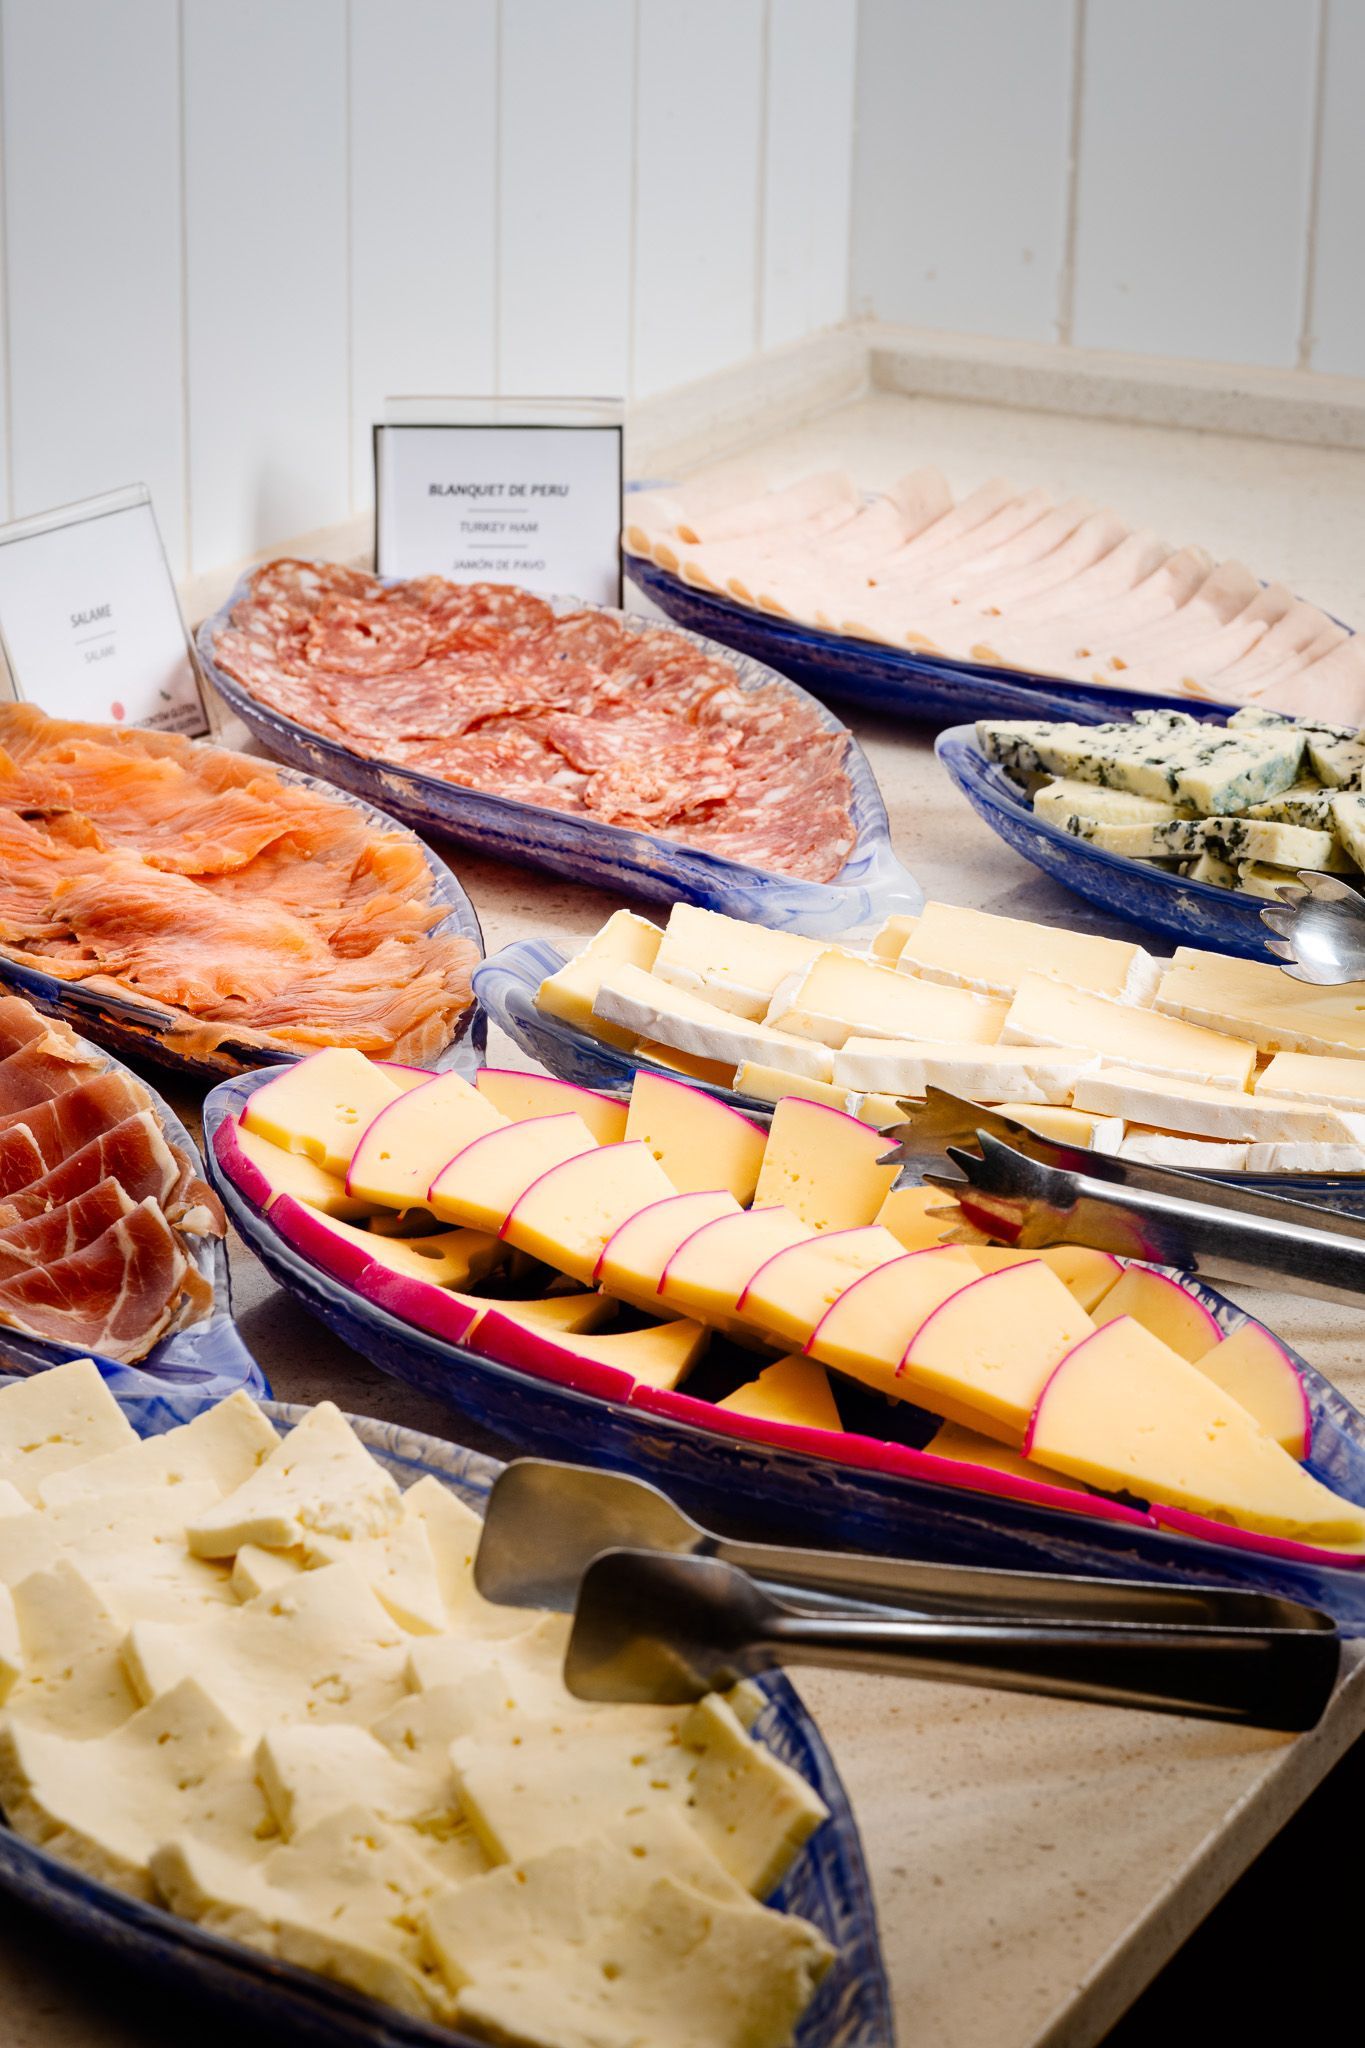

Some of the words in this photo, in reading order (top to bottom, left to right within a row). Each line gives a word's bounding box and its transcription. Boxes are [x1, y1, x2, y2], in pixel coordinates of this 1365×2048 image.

[428, 484, 503, 498] BLANQUET
[508, 484, 527, 496] DE
[530, 484, 569, 496] PERU
[460, 521, 506, 533] TURKEY
[509, 521, 539, 533] HAM
[496, 559, 510, 571] DE
[512, 559, 546, 571] PAVO
[70, 603, 112, 628] SALAME
